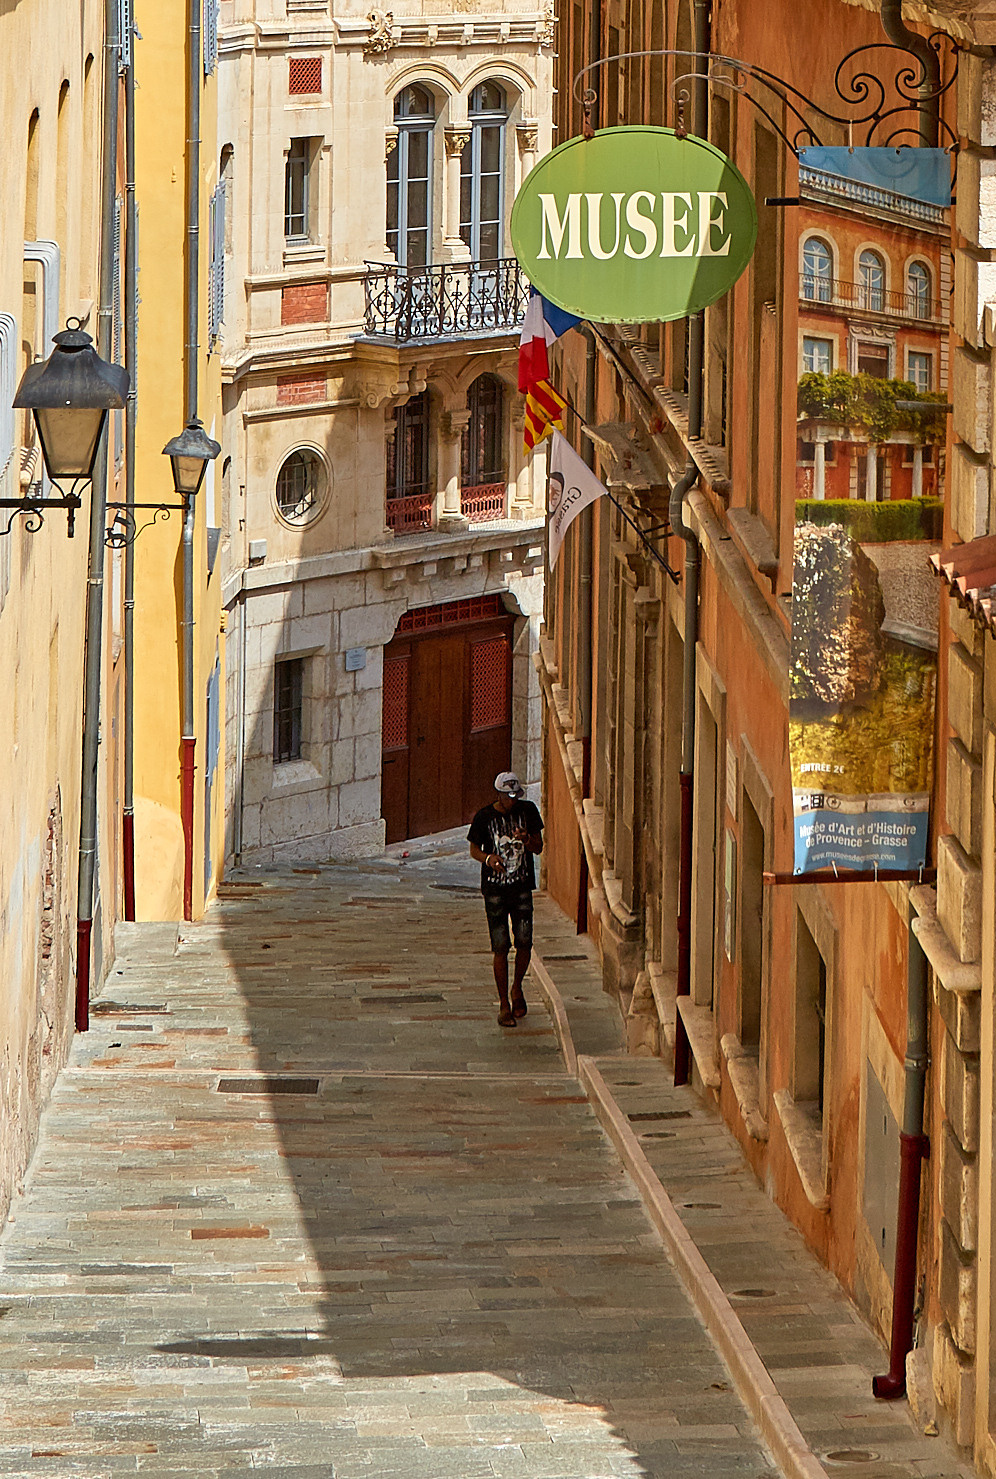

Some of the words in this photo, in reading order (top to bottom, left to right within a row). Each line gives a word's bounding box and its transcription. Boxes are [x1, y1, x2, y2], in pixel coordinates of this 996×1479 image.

[536, 191, 732, 260] MUSEE
[799, 821, 826, 839] Musée
[828, 822, 855, 836] d'Art
[856, 825, 866, 836] et
[867, 823, 917, 836] d'Histoire
[805, 835, 815, 849] de
[816, 833, 863, 848] Provence
[872, 834, 908, 847] Grasse
